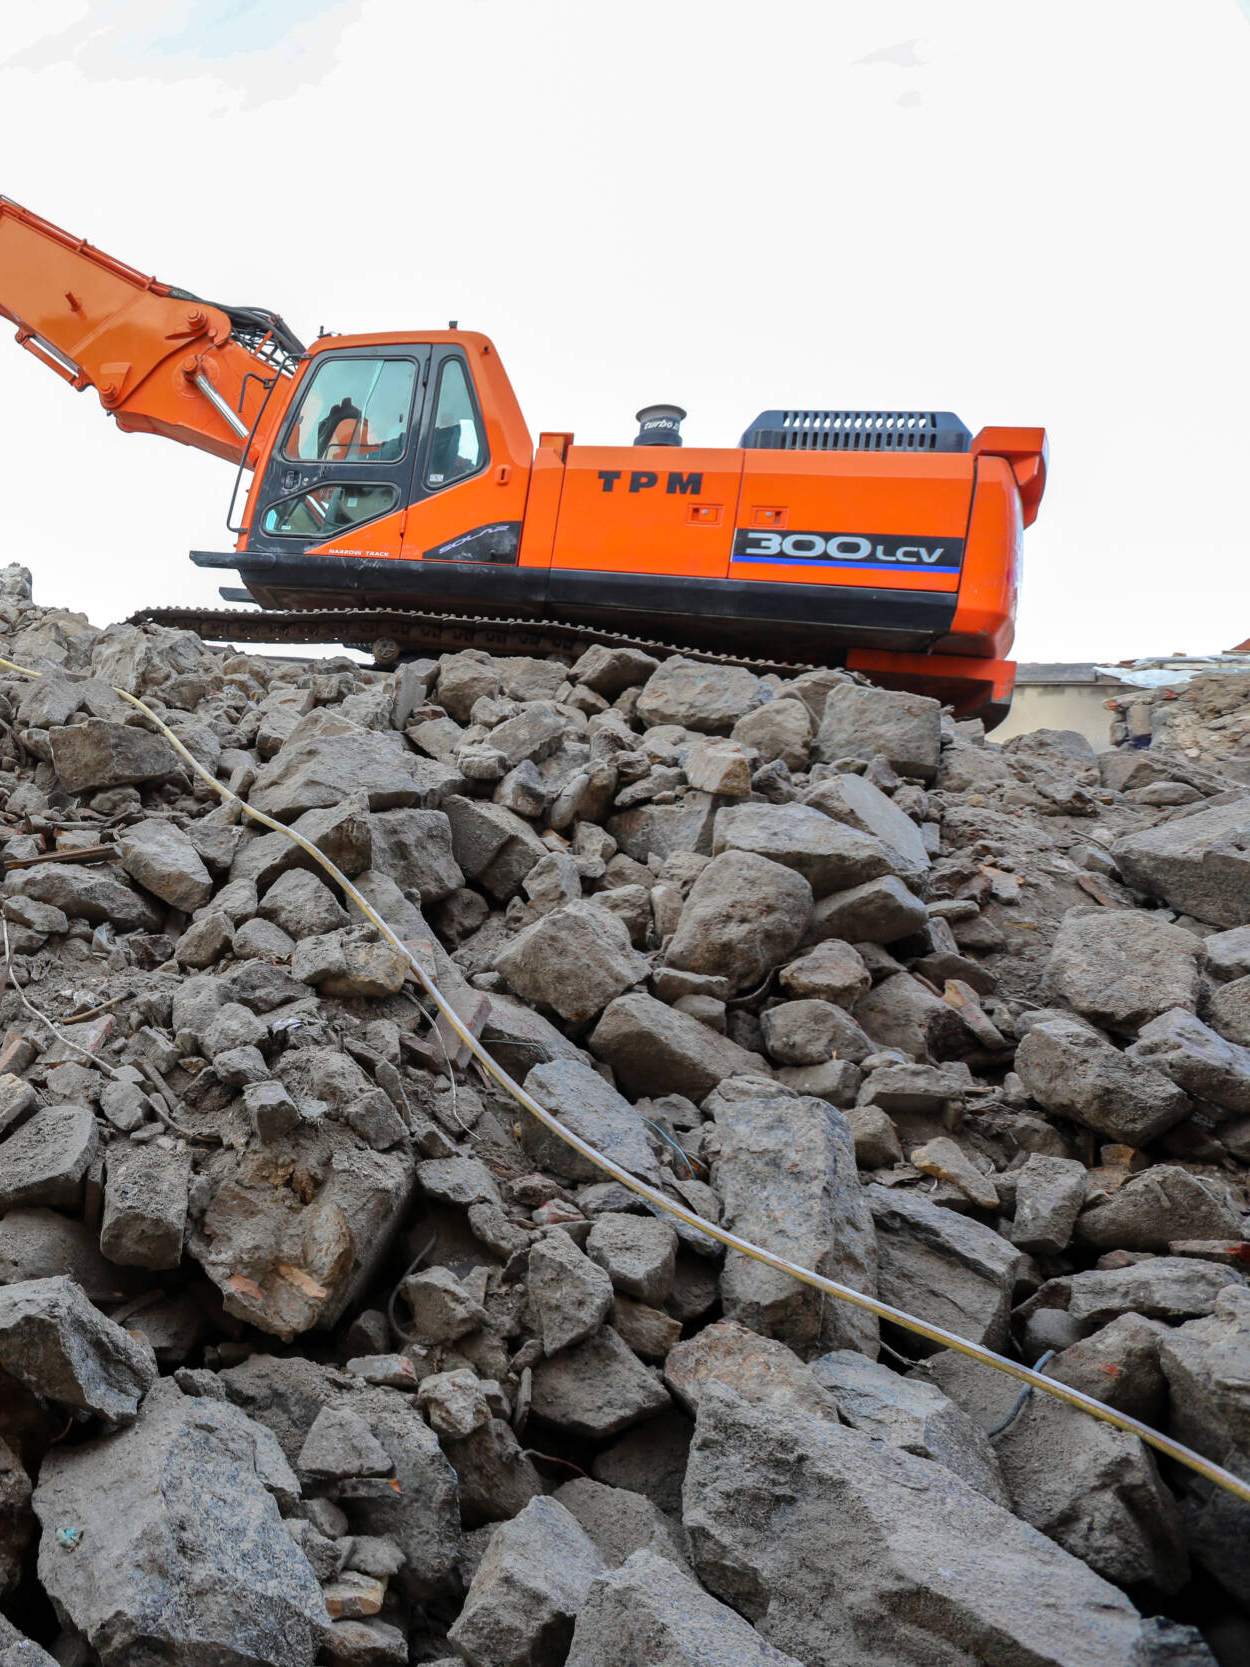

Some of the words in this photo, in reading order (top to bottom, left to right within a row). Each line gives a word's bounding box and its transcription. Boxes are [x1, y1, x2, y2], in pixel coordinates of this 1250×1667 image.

[643, 419, 673, 430] turbo
[597, 470, 704, 495] TPM
[745, 532, 872, 560] 300
[875, 545, 944, 563] LCV
